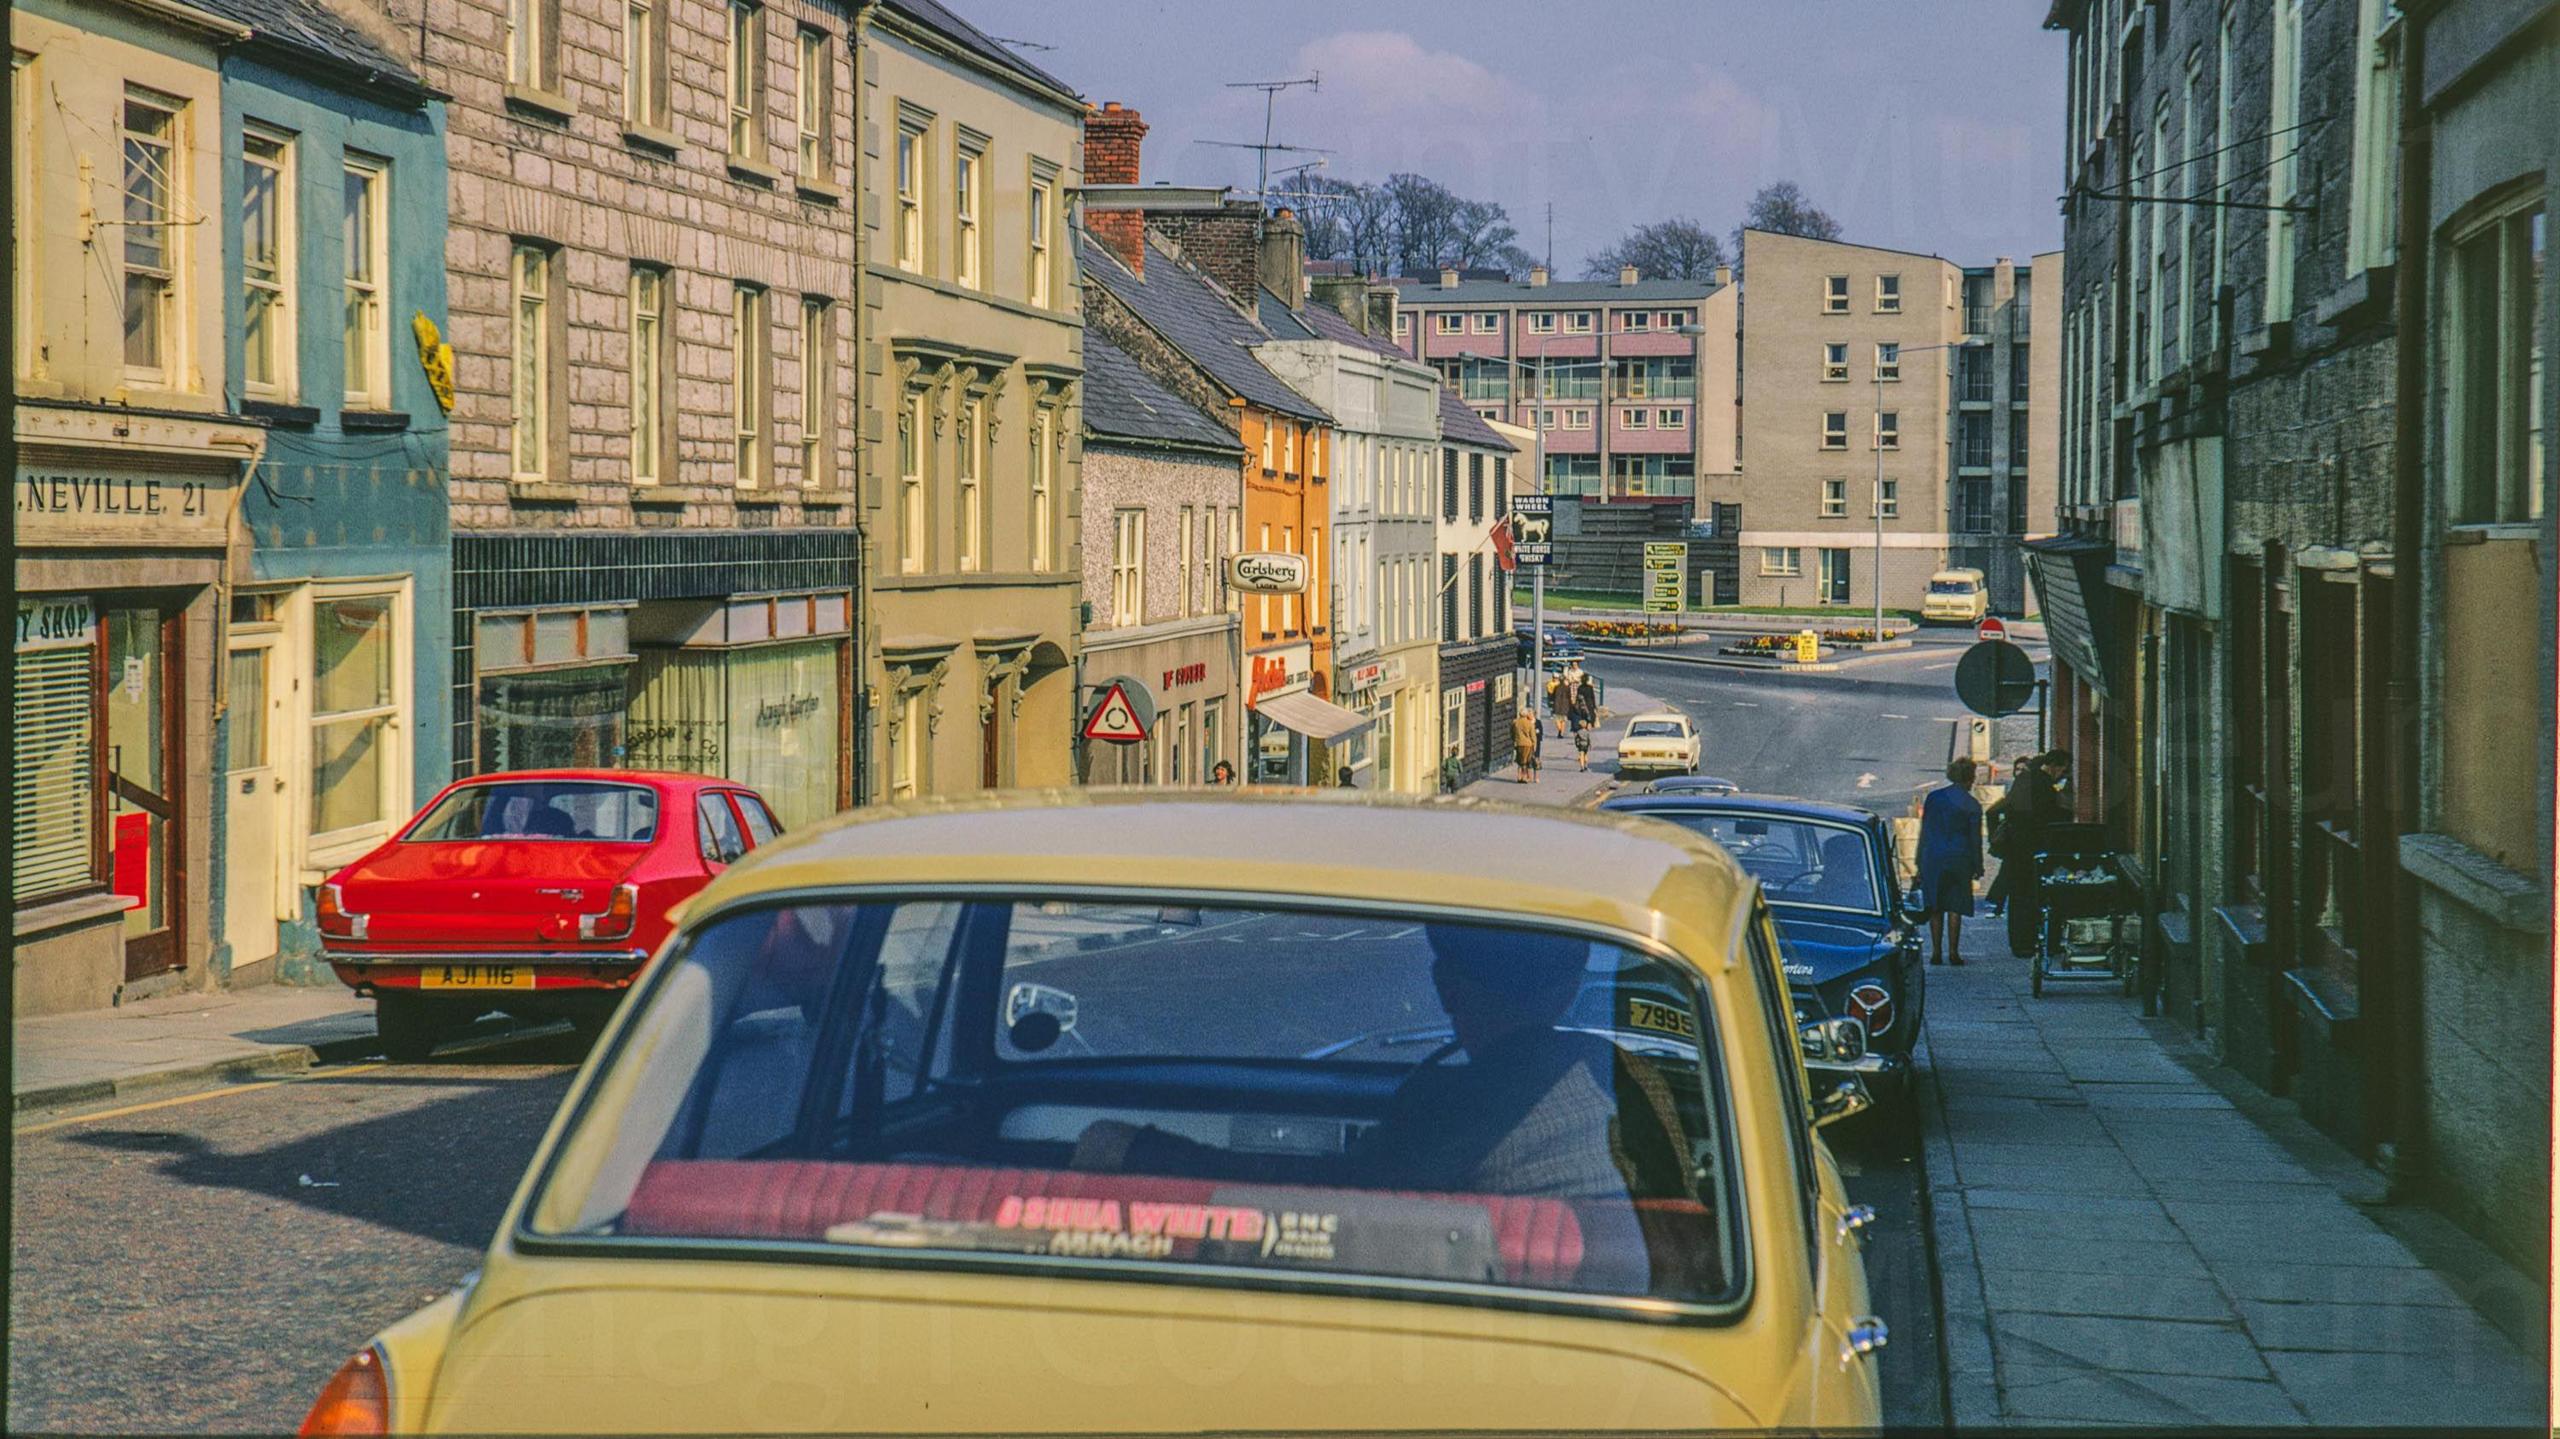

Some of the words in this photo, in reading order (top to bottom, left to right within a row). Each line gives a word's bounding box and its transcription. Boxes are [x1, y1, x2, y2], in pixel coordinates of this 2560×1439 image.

[182, 481, 206, 517] 21
[1514, 496, 1549, 504] WAGON
[1237, 558, 1297, 581] Carlsberg
[40, 604, 88, 640] SHOP
[701, 738, 719, 755] CO
[1640, 1003, 1694, 1034] 7995
[1130, 1201, 1264, 1242] WHITE
[1050, 1230, 1174, 1256] ARMAGH
